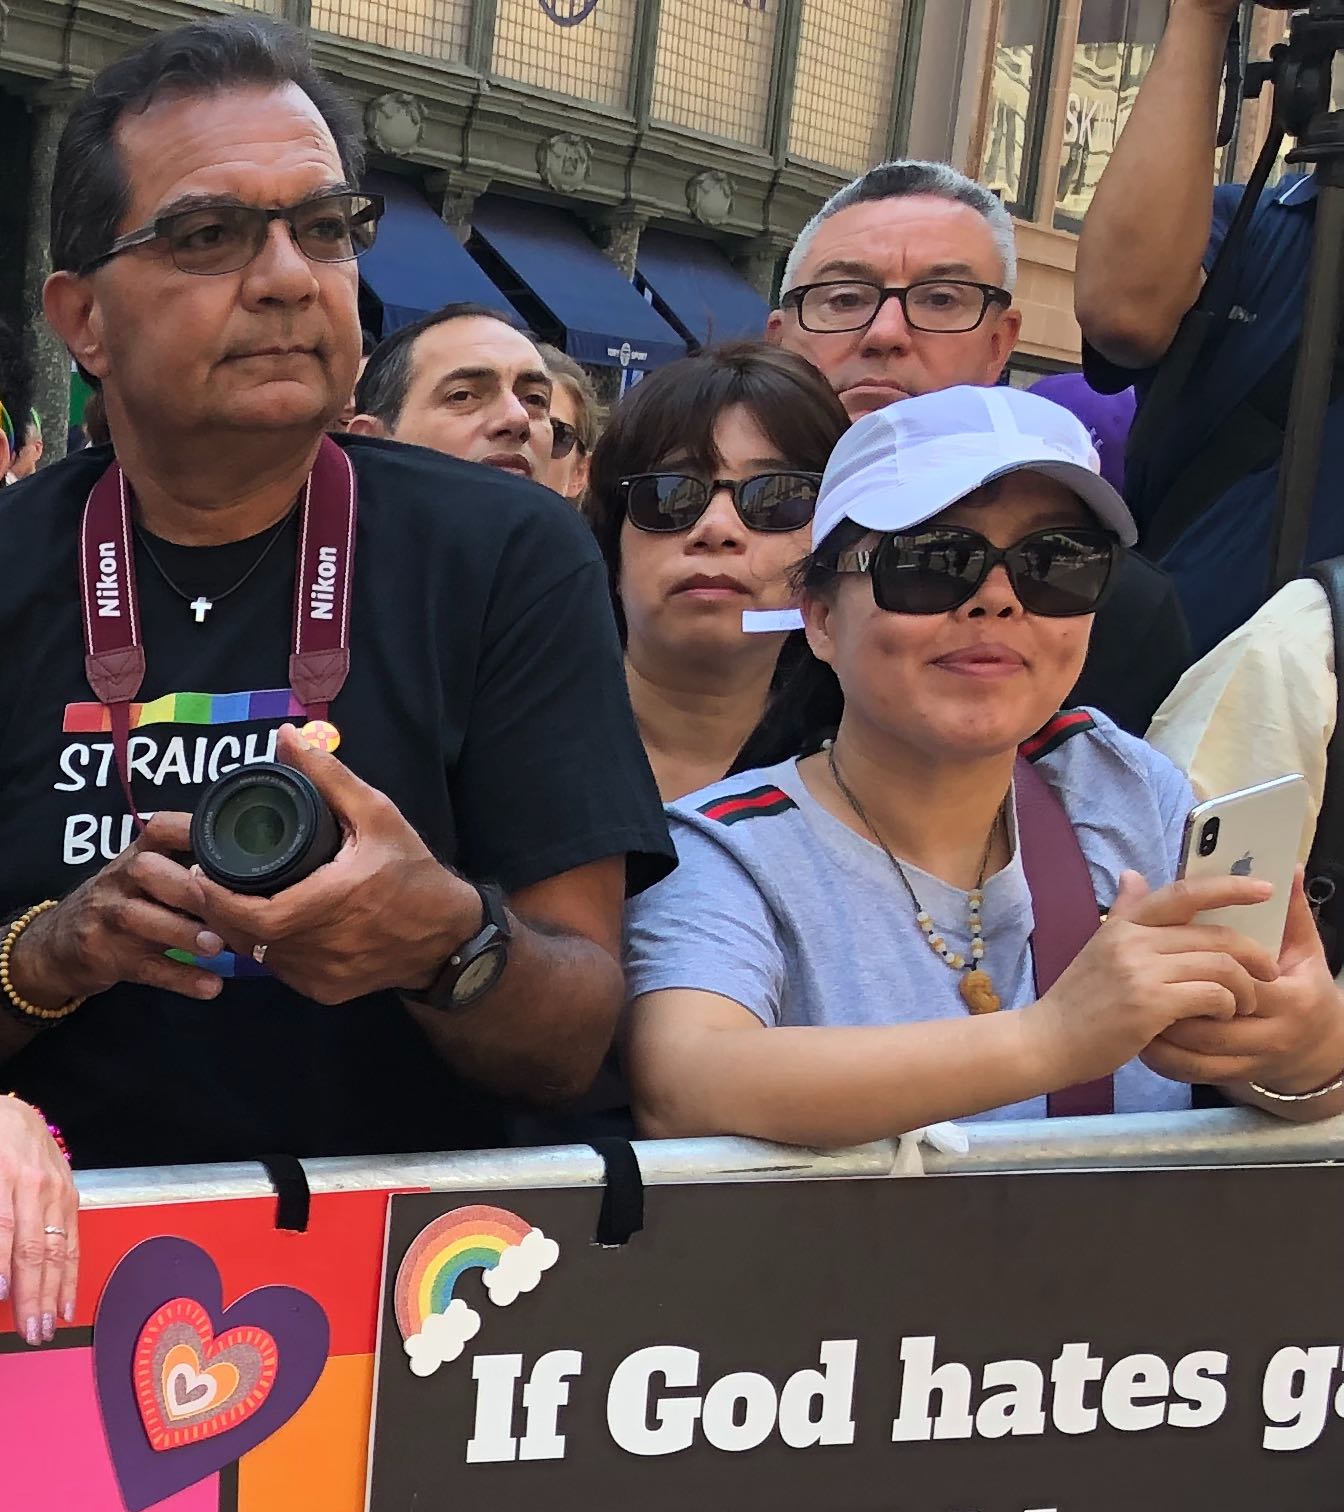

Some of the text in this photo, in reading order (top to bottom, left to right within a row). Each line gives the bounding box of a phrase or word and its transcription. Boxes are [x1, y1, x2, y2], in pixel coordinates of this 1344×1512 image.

[95, 541, 121, 618] Nikon
[310, 546, 338, 620] Nikon
[53, 728, 279, 792] STRAIGH
[62, 811, 157, 865] BU
[466, 1335, 1344, 1464] If God hates g
